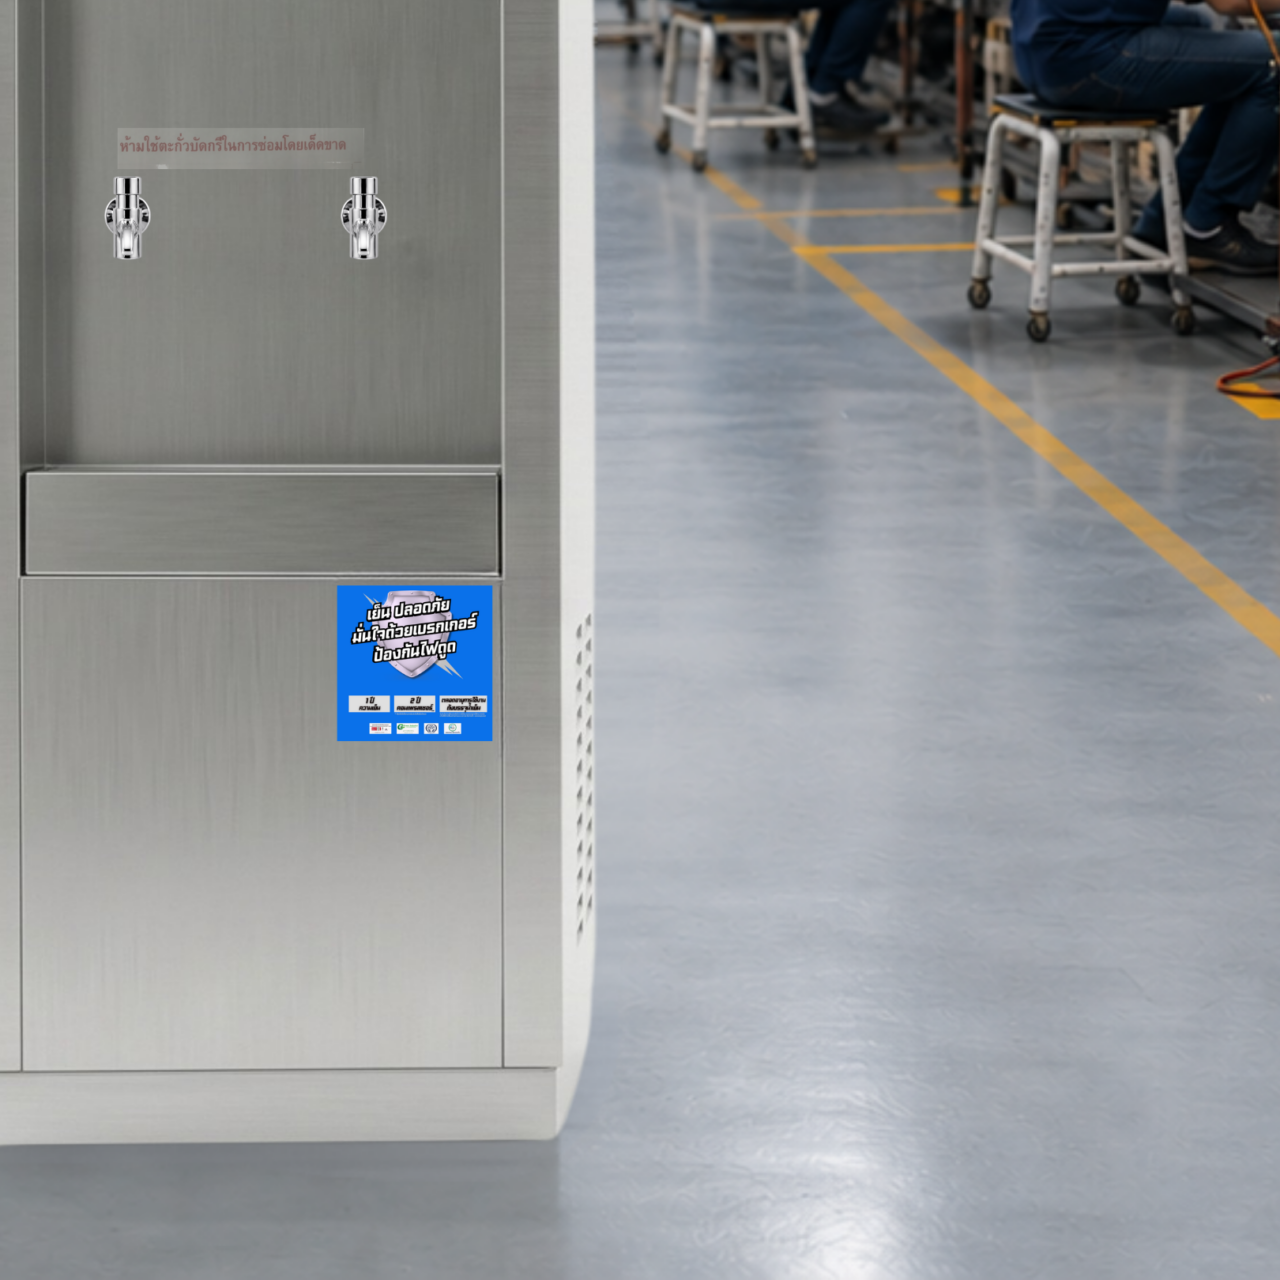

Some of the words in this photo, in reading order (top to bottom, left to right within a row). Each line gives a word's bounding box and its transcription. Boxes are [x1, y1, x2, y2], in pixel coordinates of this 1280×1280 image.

[367, 603, 391, 621] เย็น
[394, 597, 451, 617] ปลอดภัย
[351, 611, 479, 644] มั่นใจด้วยเบรกเกอร์
[373, 639, 457, 662] ป้องกันไฟดูด
